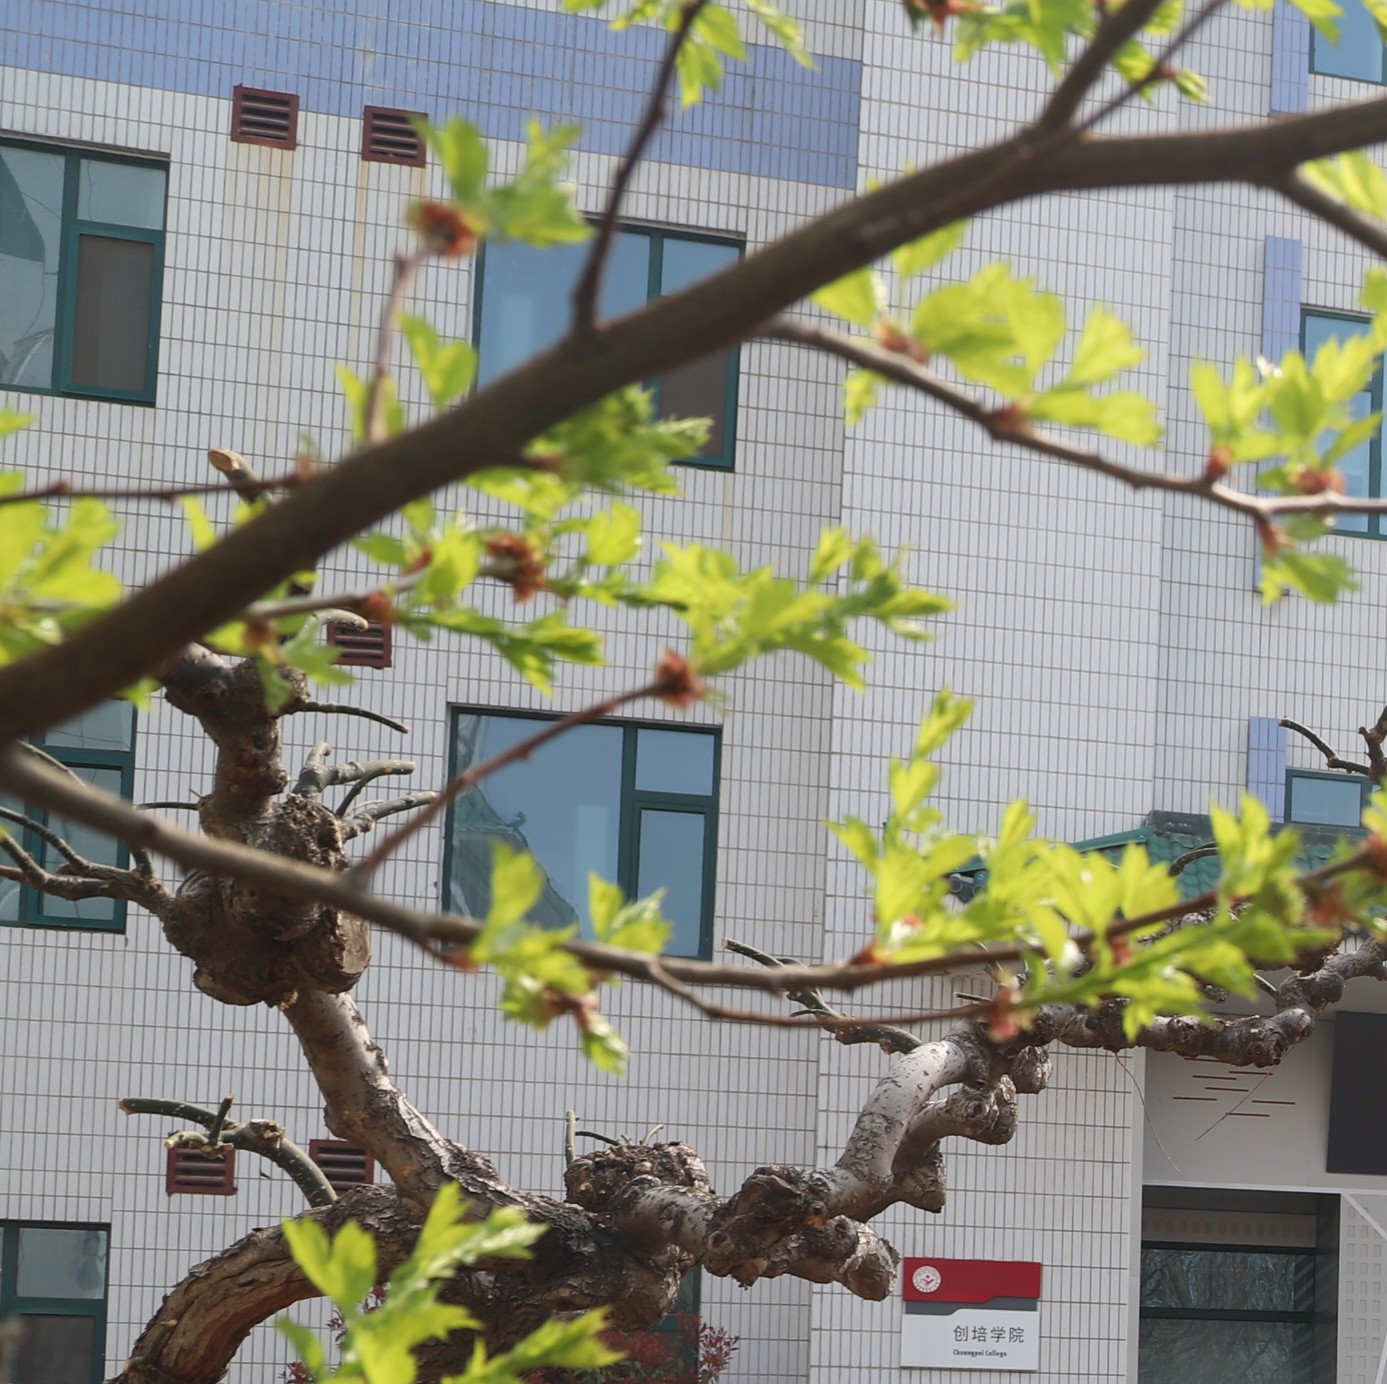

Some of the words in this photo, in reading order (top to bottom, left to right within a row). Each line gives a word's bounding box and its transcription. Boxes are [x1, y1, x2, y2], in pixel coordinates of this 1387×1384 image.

[953, 1325, 1025, 1344] 创培学院
[985, 1350, 1007, 1358] College
